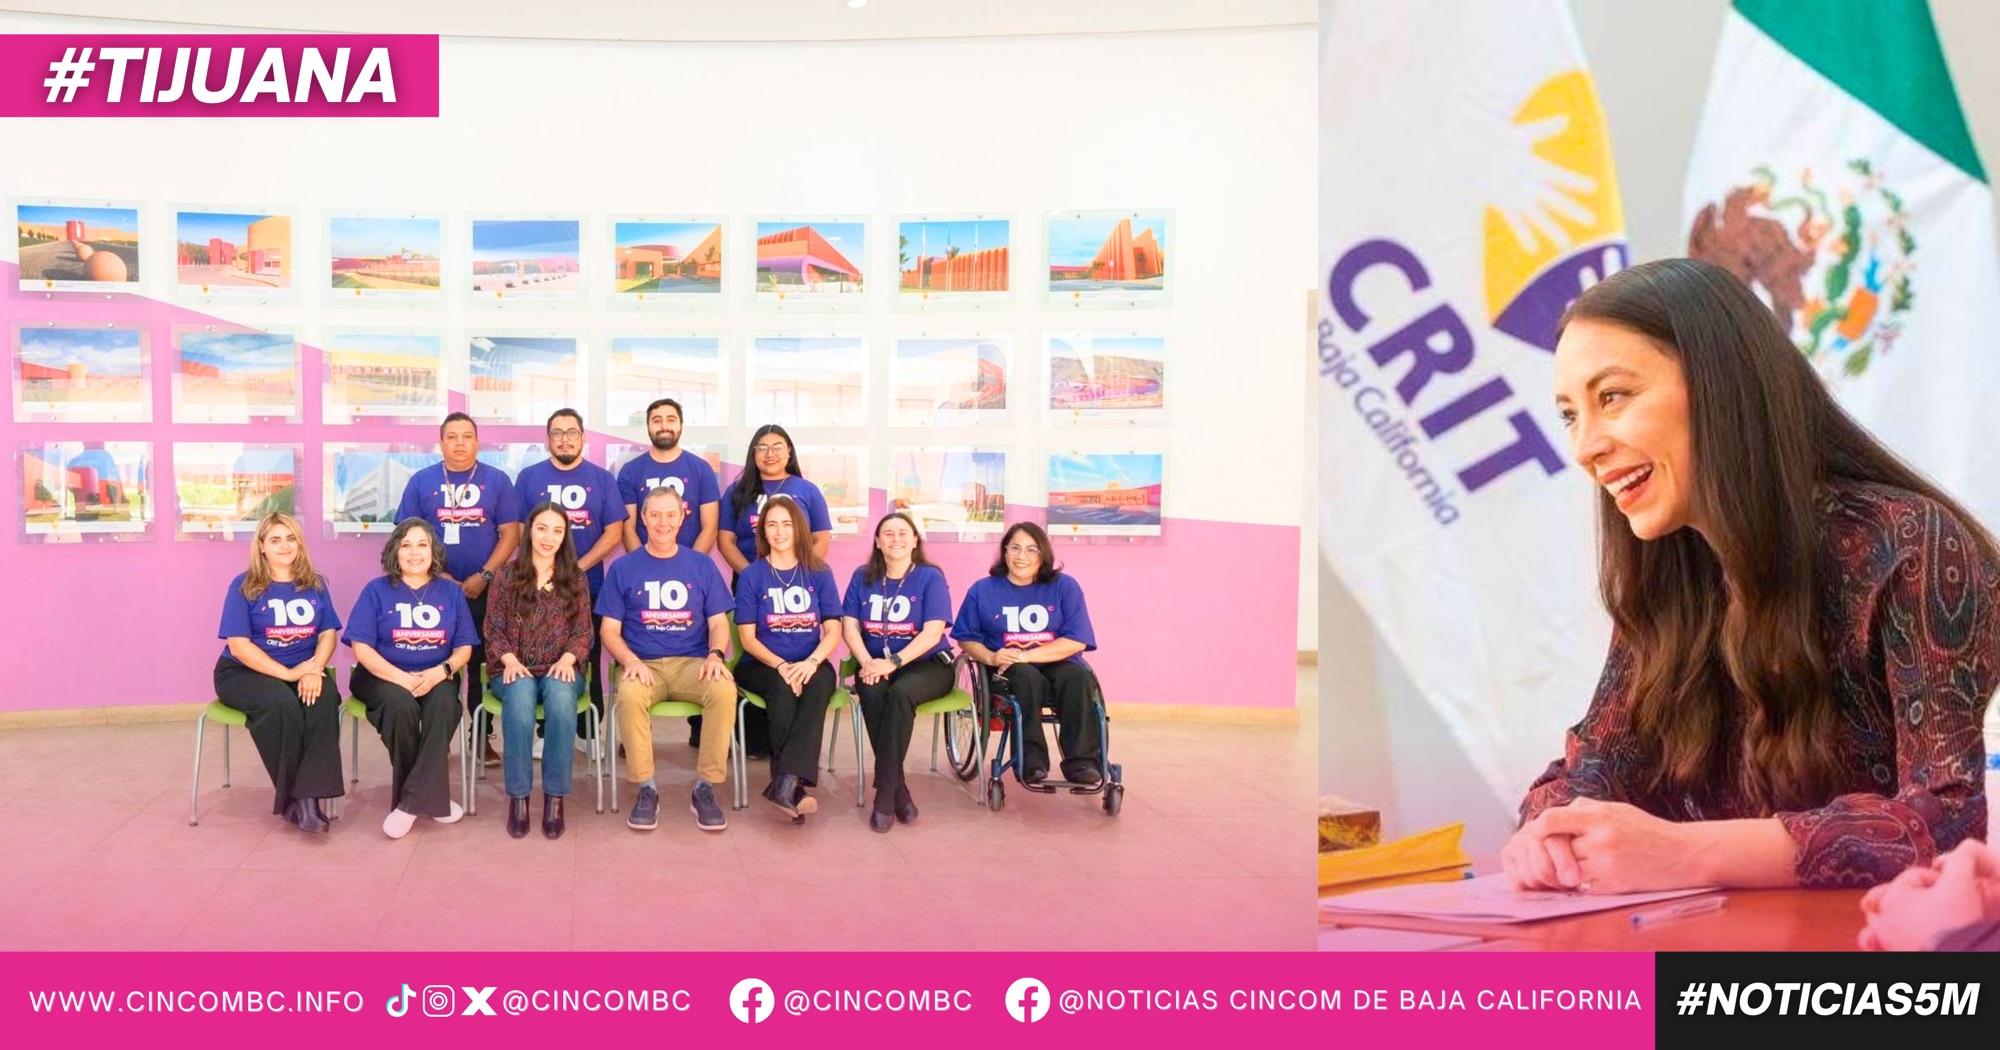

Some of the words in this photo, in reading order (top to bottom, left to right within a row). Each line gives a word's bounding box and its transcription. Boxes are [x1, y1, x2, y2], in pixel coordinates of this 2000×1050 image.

[1329, 238, 1566, 493] CRIT
[1354, 386, 1460, 525] California
[440, 483, 480, 508] 10
[547, 484, 587, 510] 10
[644, 580, 689, 610] 10
[767, 585, 812, 614] 10
[869, 594, 911, 622] 10
[267, 598, 315, 626] 10
[395, 602, 441, 629] 10
[1002, 604, 1050, 633] 10
[269, 627, 314, 635] ANIVERSARIO
[1005, 633, 1052, 641] ANIVERSARIO
